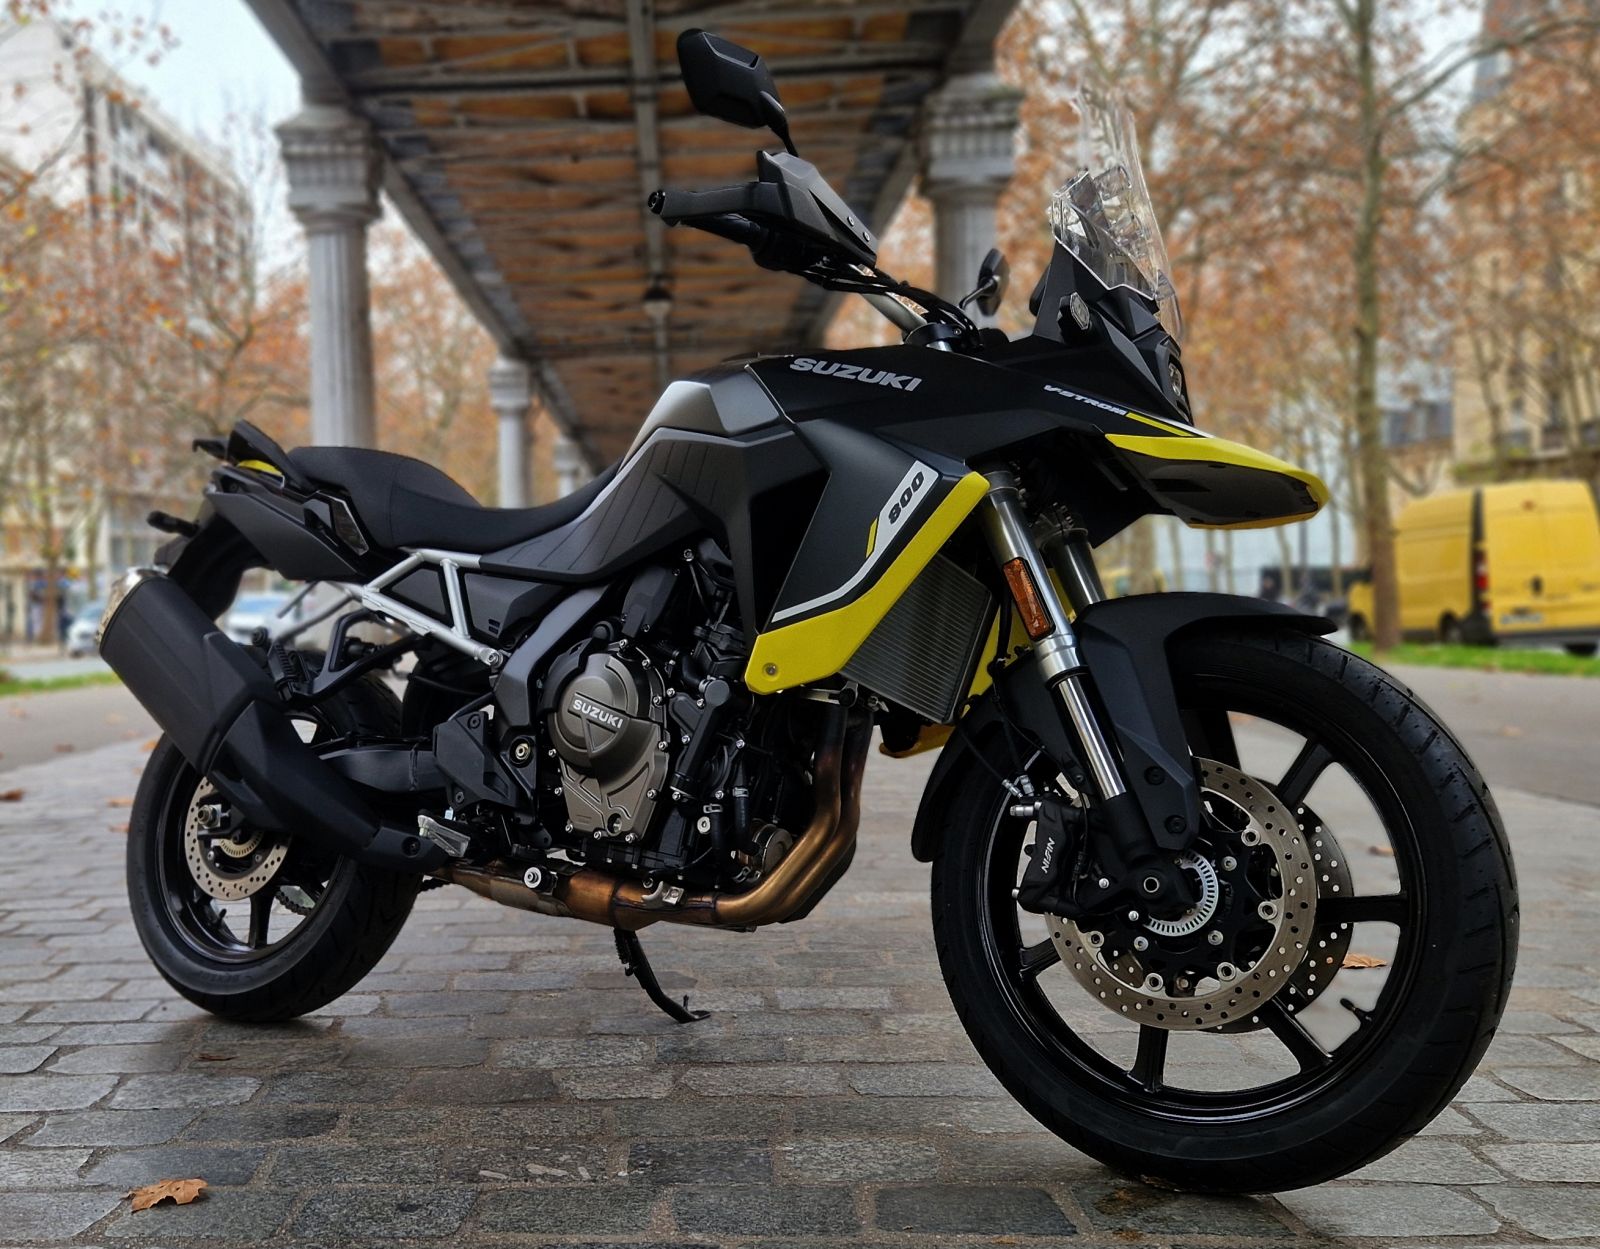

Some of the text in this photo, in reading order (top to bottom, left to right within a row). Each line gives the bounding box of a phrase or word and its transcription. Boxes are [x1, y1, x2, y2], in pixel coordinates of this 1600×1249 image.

[789, 358, 922, 392] SUZUKI
[888, 471, 925, 525] 800
[572, 699, 624, 729] SUZUKI
